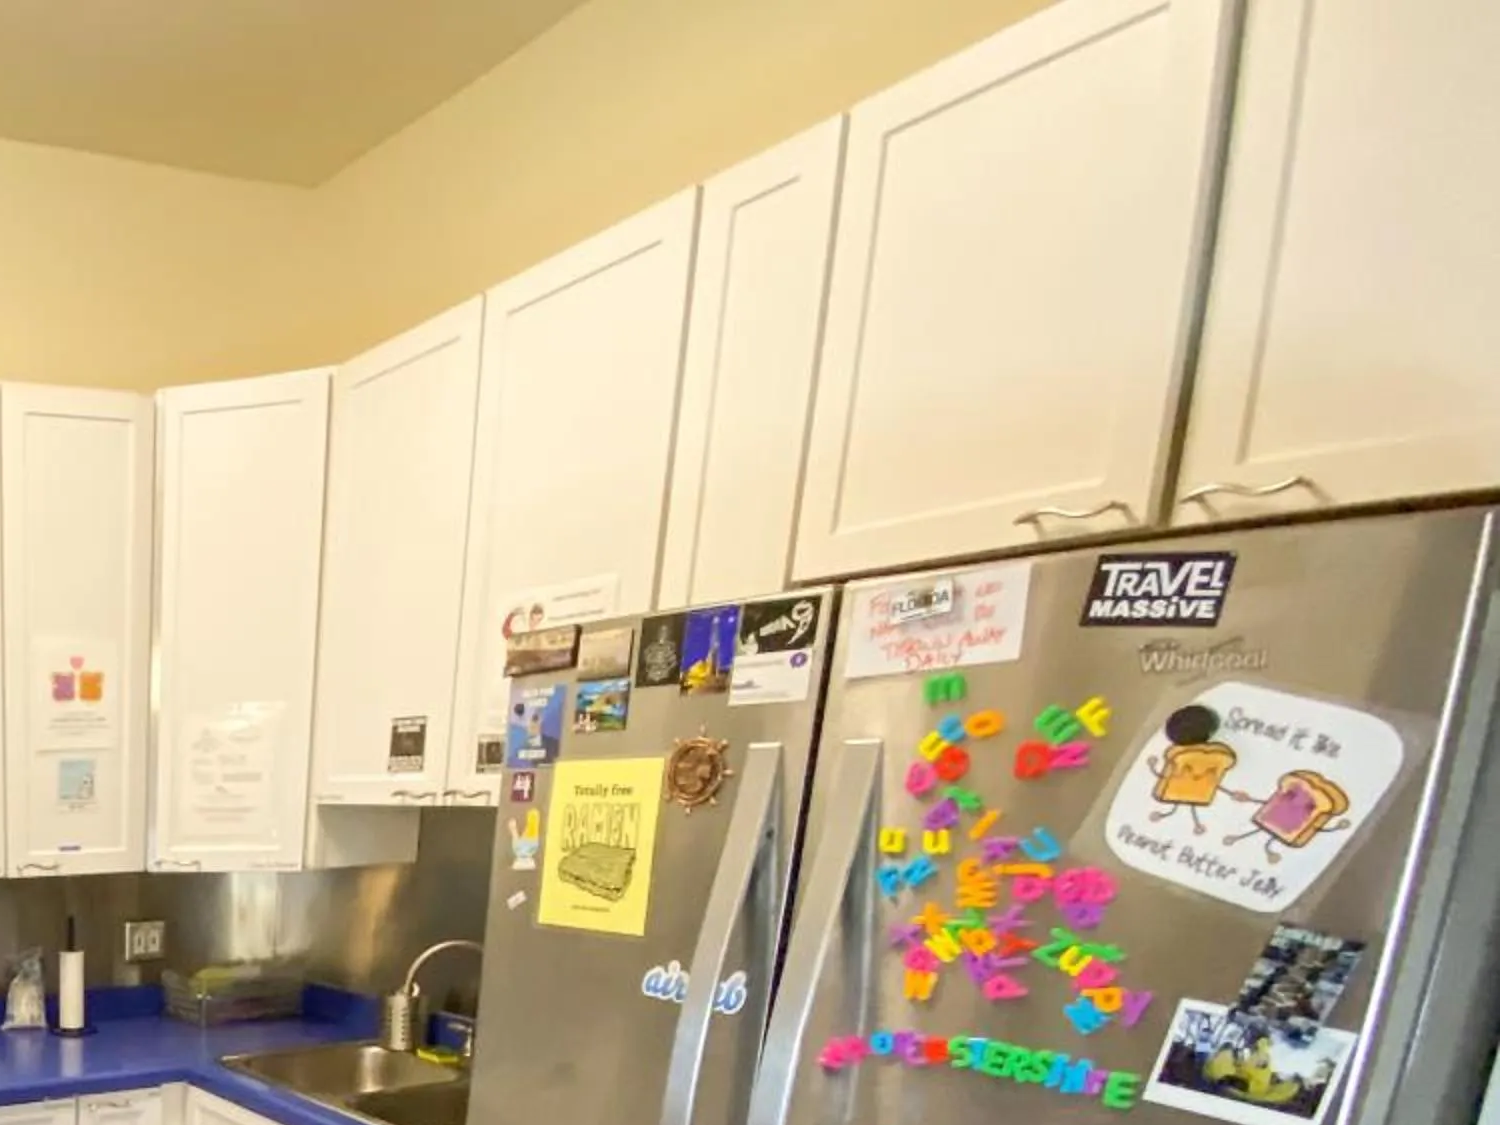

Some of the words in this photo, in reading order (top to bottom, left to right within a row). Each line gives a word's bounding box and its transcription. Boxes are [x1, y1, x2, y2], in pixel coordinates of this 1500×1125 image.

[1101, 560, 1225, 597] TRAVEL
[1224, 706, 1289, 741] Spread
[574, 785, 608, 797] Totally
[611, 784, 634, 796] free
[561, 803, 641, 852] RAMEN
[1117, 824, 1174, 861] Peanut
[1176, 846, 1237, 880] Butter
